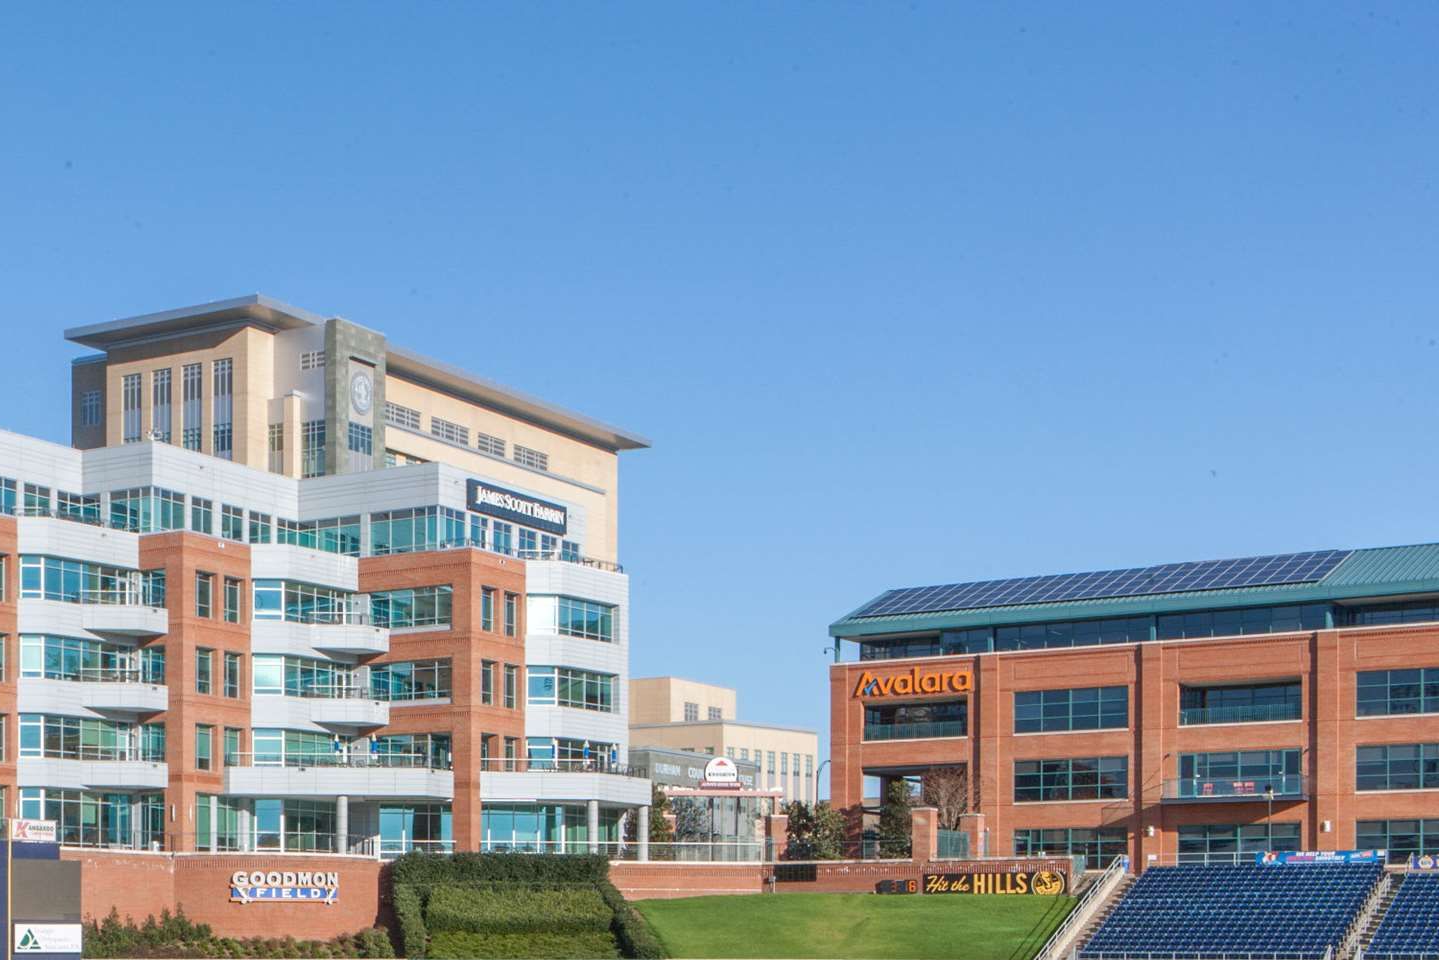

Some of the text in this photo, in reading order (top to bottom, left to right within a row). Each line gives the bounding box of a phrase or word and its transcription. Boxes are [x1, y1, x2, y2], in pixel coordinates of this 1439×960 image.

[475, 486, 505, 508] JAMES
[505, 494, 535, 515] SCOTT
[854, 664, 972, 697] Avalara
[232, 871, 338, 887] GOODMON
[926, 873, 1027, 894] Hit the HILLS
[256, 888, 321, 898] FIELD
